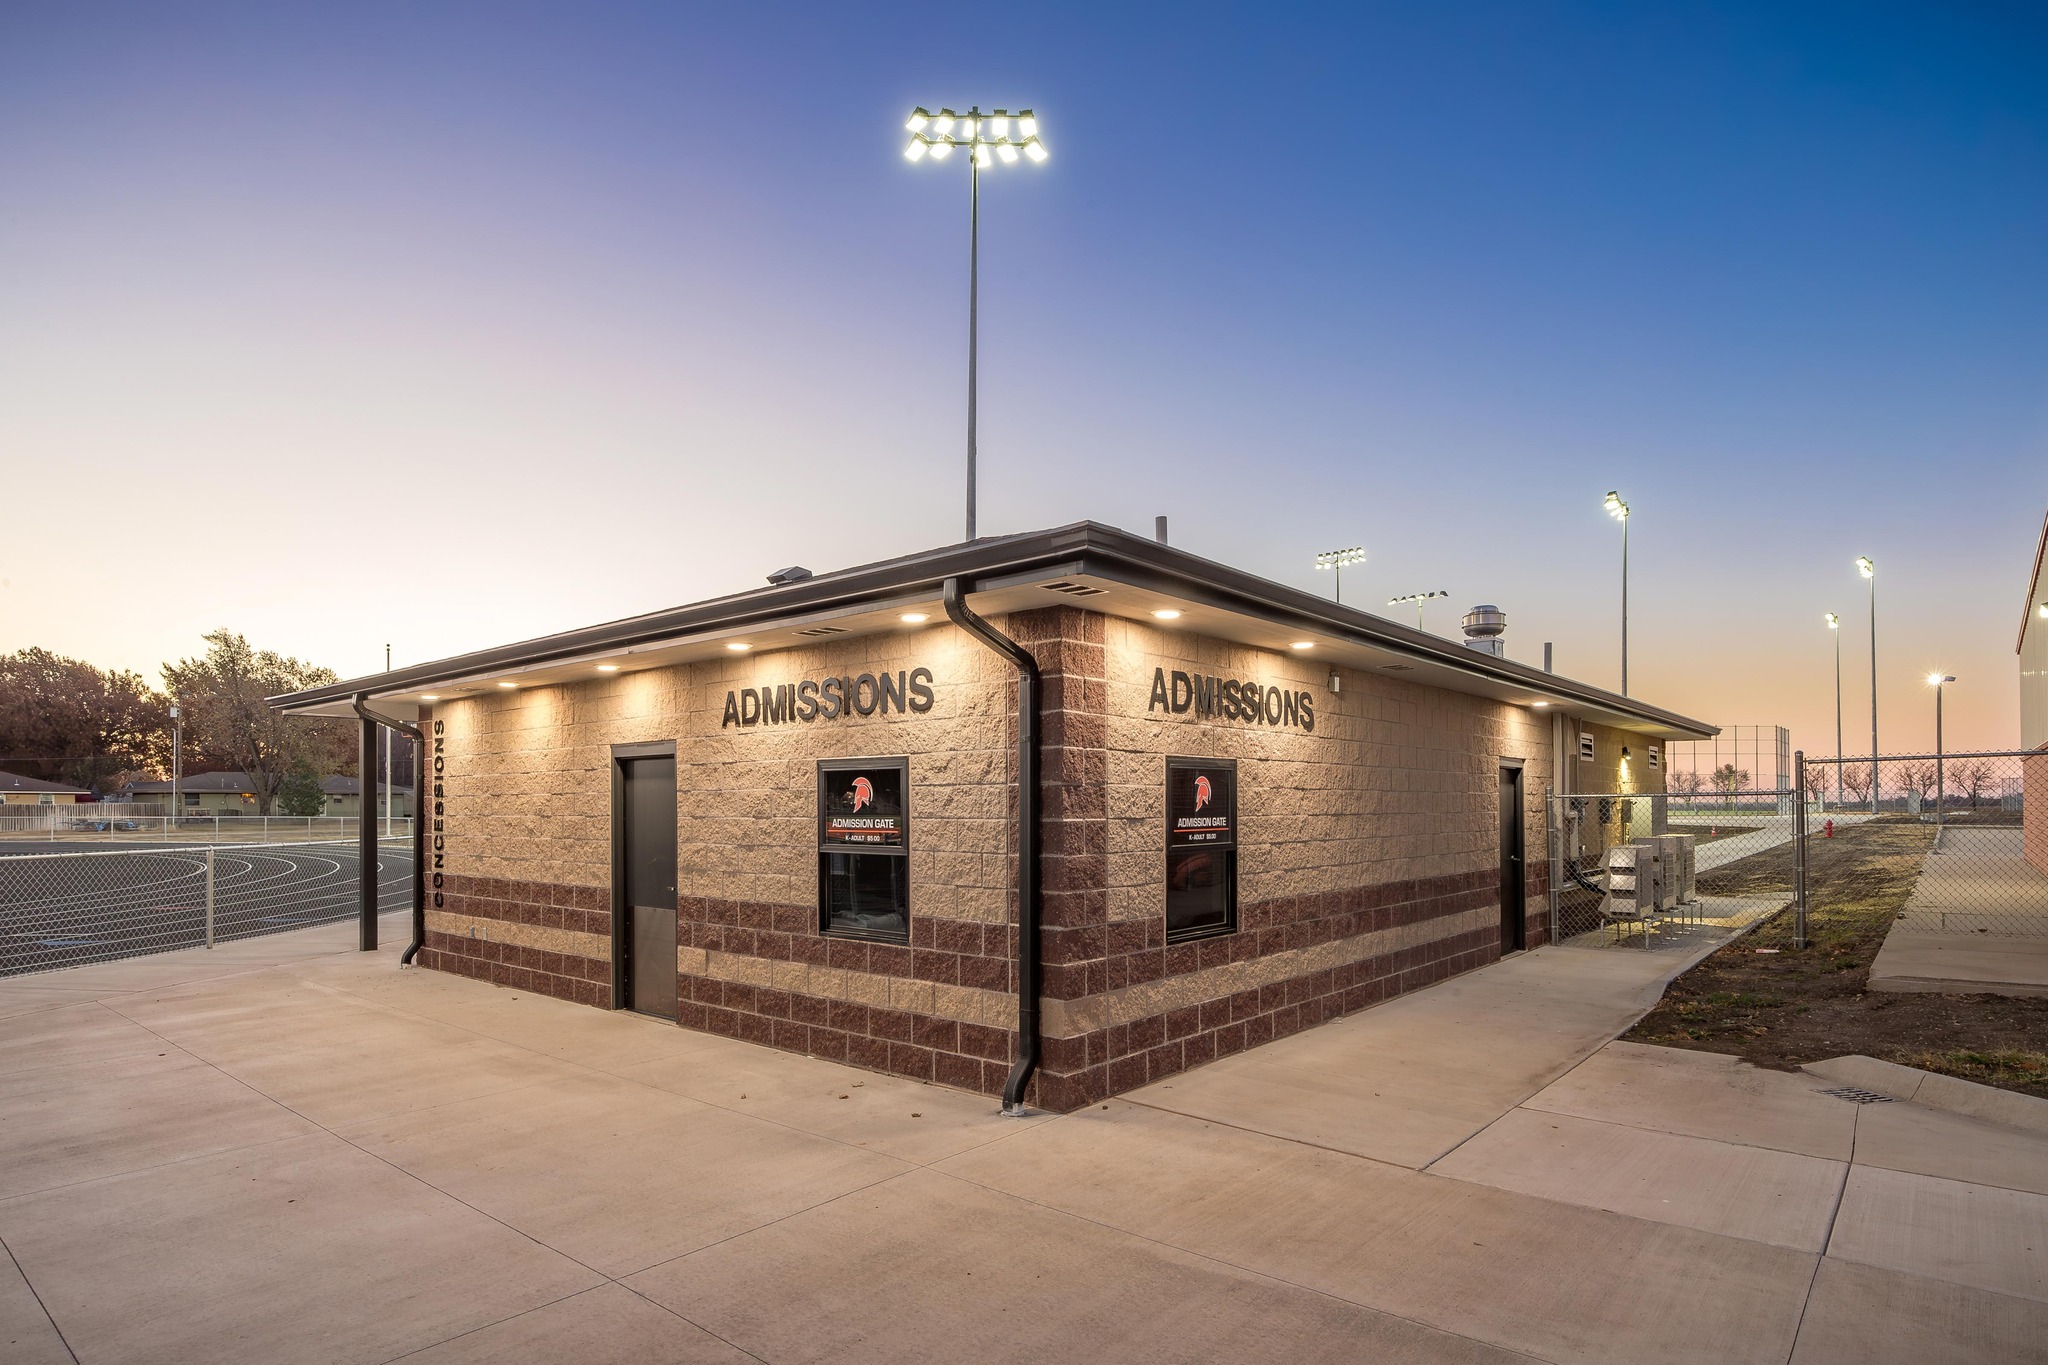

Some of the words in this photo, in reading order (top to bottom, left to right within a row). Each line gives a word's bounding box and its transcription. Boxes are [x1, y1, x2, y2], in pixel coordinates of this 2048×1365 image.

[722, 667, 935, 728] ADMISSIONS
[1148, 667, 1315, 732] ADMISSIONS
[433, 719, 445, 908] CONCESSIONS
[832, 819, 874, 828] ADMISSION
[874, 819, 894, 828] GATE
[1178, 817, 1212, 828] ADMISSION
[1212, 817, 1227, 826] GATE
